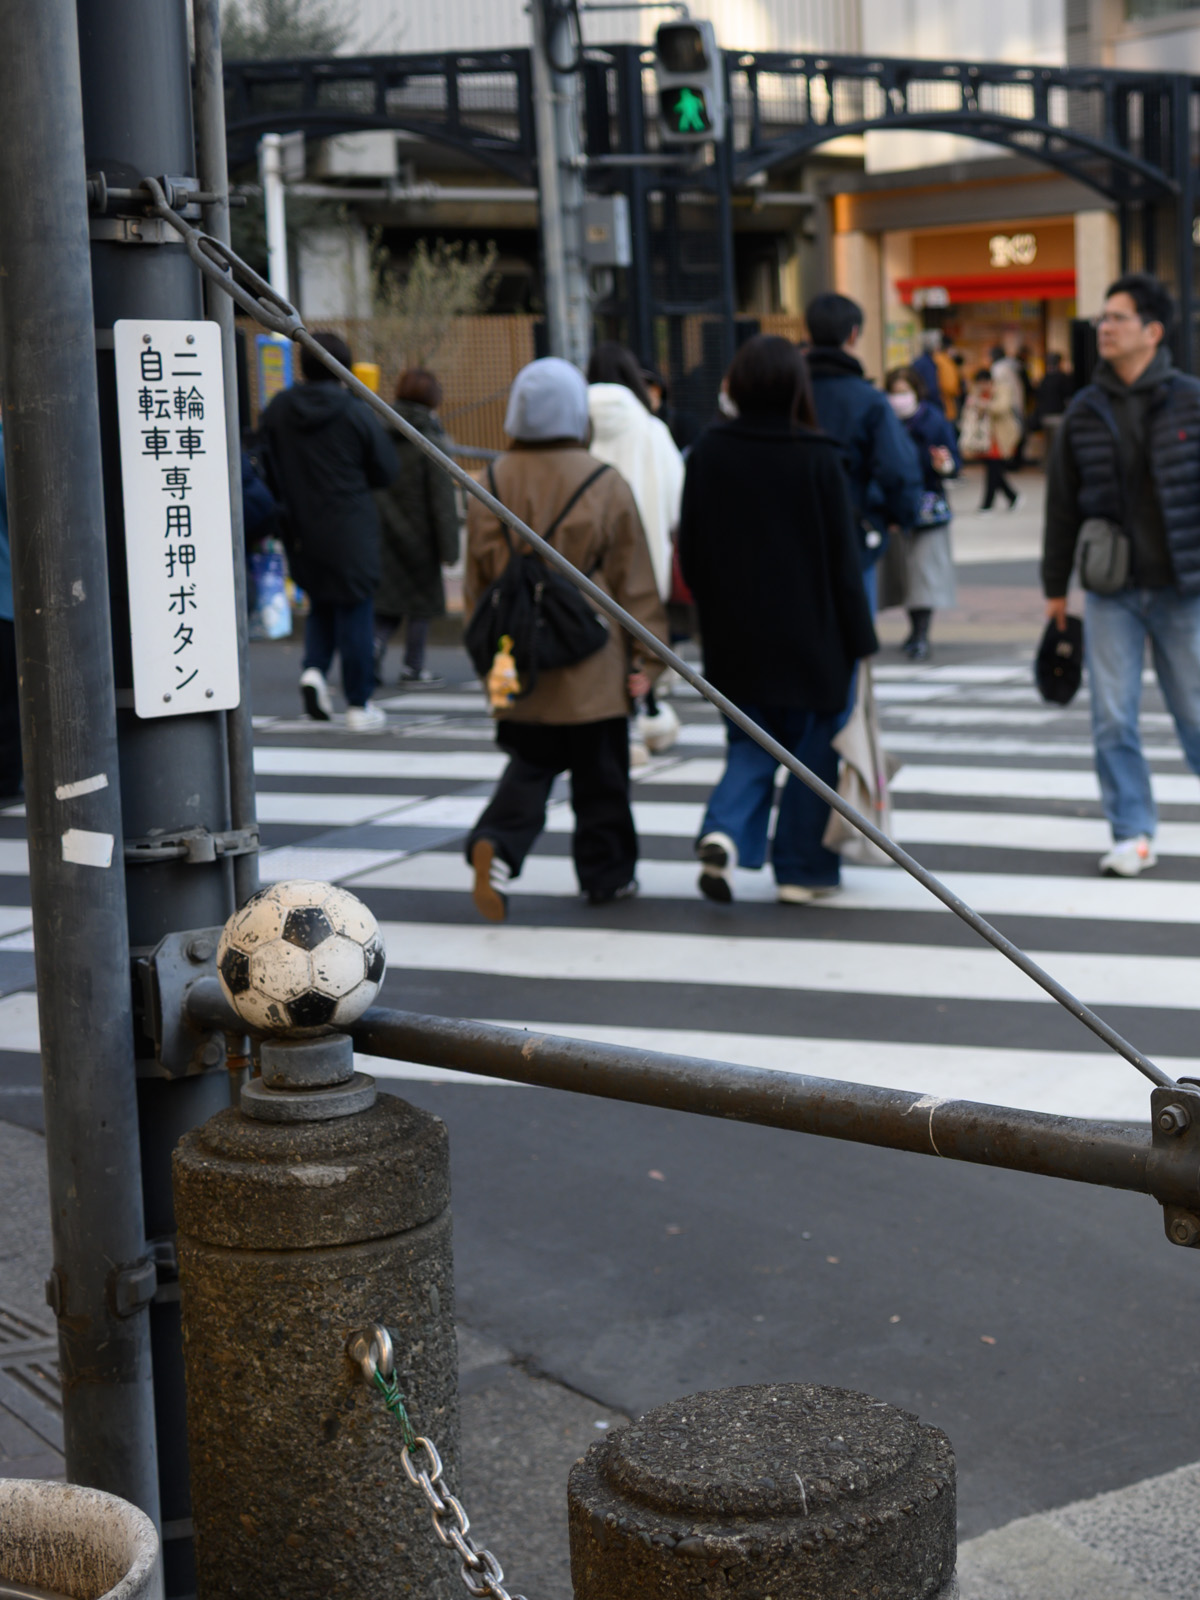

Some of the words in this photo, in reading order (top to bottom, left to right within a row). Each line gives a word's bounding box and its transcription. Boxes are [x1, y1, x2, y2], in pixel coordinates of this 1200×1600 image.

[138, 346, 173, 461] 自転車
[172, 352, 206, 460] 二輪車
[161, 466, 199, 690] 専用押ボタン
